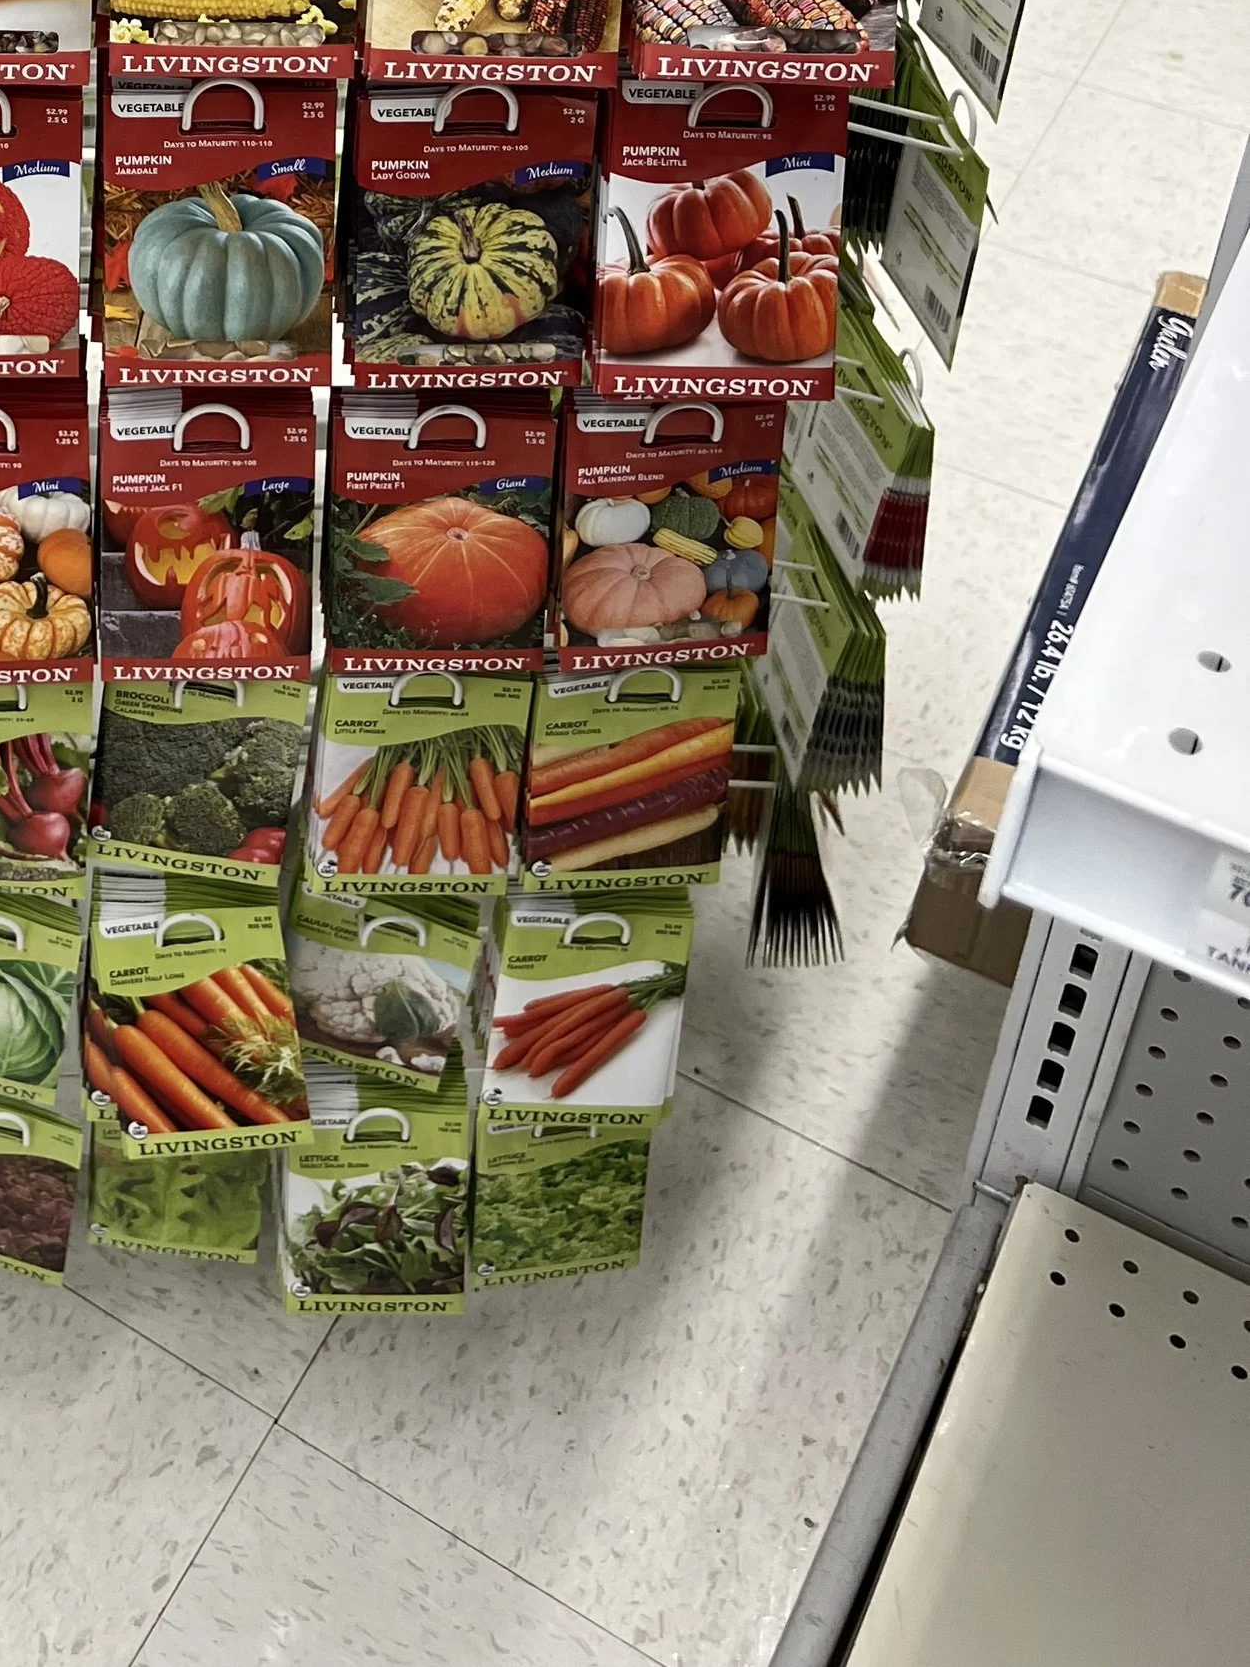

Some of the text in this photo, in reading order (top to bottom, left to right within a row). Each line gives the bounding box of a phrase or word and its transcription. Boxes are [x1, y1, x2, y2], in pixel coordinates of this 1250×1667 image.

[122, 55, 332, 74] LIVINGSTON
[658, 57, 873, 82] LIVINGSTON
[384, 62, 597, 83] LIVINGSTON
[629, 88, 697, 100] VEGETABLE
[118, 102, 185, 113] VEGETABLE
[623, 146, 679, 157] PUMPKIN
[115, 155, 172, 166] PUMPKIN
[271, 159, 306, 175] Small
[371, 160, 429, 171] PUMPKIN
[784, 155, 811, 170] Mini
[14, 162, 61, 177] Medium
[526, 164, 573, 180] Medium
[120, 368, 313, 384] LIVINGSTON
[368, 370, 562, 388] LIVINGSTON
[614, 376, 813, 395] LIVINGSTON
[582, 418, 647, 429] VEGETABLE
[347, 471, 401, 482] PUMPKIN
[578, 464, 631, 477] PUMPKIN
[718, 463, 762, 477] Medium
[112, 474, 166, 484] PUMPKIN
[261, 479, 290, 491] Large
[495, 477, 527, 490] Giant
[32, 480, 60, 493] Mini
[1041, 620, 1075, 660] 26.4
[344, 657, 526, 671] LIVINGSTON
[113, 665, 295, 680] LIVINGSTON
[115, 691, 170, 704] BROCCOLI
[335, 719, 379, 728] CARROT
[545, 720, 588, 731] CARROT
[97, 844, 260, 881] LIVINGSTON
[323, 881, 489, 894] LIVINGSTON
[109, 967, 149, 977] CARROT
[488, 1109, 644, 1125] LIVINGSTON
[139, 1132, 296, 1156] LIVINGSTON
[298, 1301, 447, 1312] LIVINGSTON
